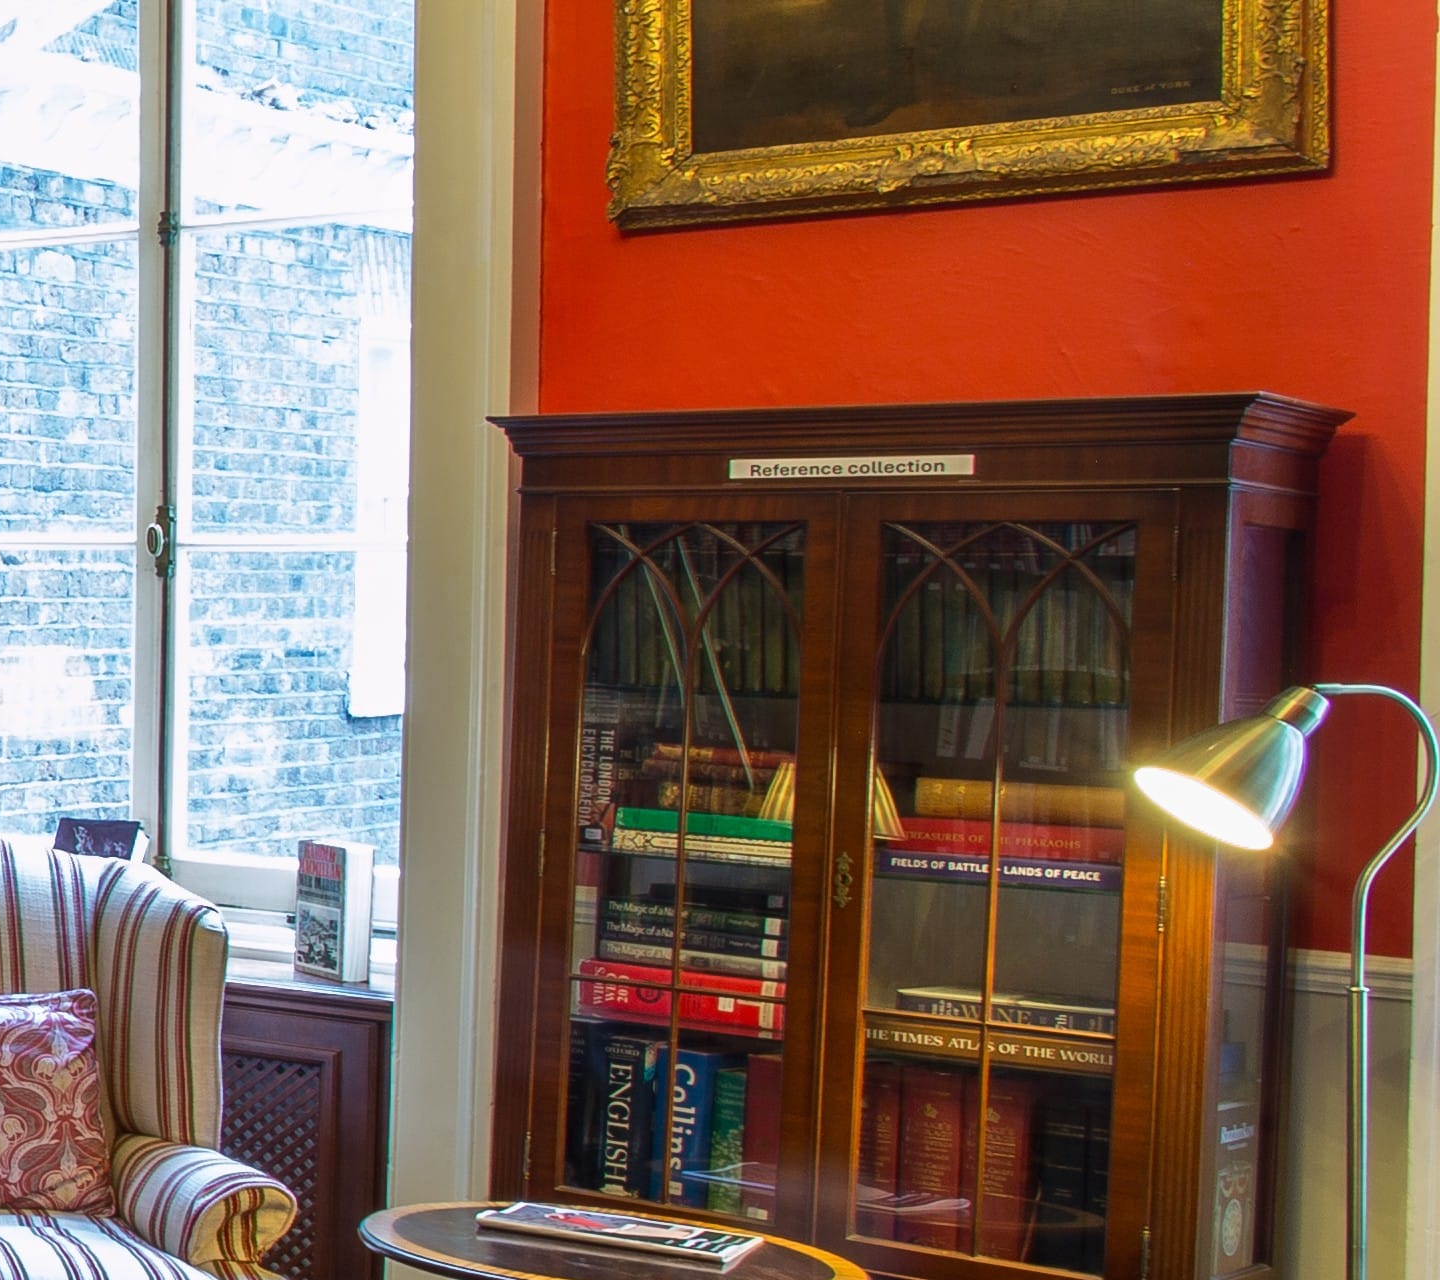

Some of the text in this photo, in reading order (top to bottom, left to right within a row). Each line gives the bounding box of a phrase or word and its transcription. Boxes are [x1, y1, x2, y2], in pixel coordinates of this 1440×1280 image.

[750, 459, 945, 477] Reference collection
[579, 728, 596, 827] ENCYCLOPAEDIA
[596, 730, 615, 804] THE LONDON
[891, 857, 1100, 881] FIELDS OF BATTLE LANDS OF PEACE
[605, 1046, 639, 1056] OXFORD
[866, 1029, 889, 1041] HE
[891, 1031, 944, 1046] TIMES
[948, 1038, 995, 1051] ATLS
[999, 1043, 1020, 1055] OF
[1023, 1045, 1056, 1059] THE
[604, 1062, 633, 1183] ENGLISH
[670, 1063, 696, 1170] Collins
